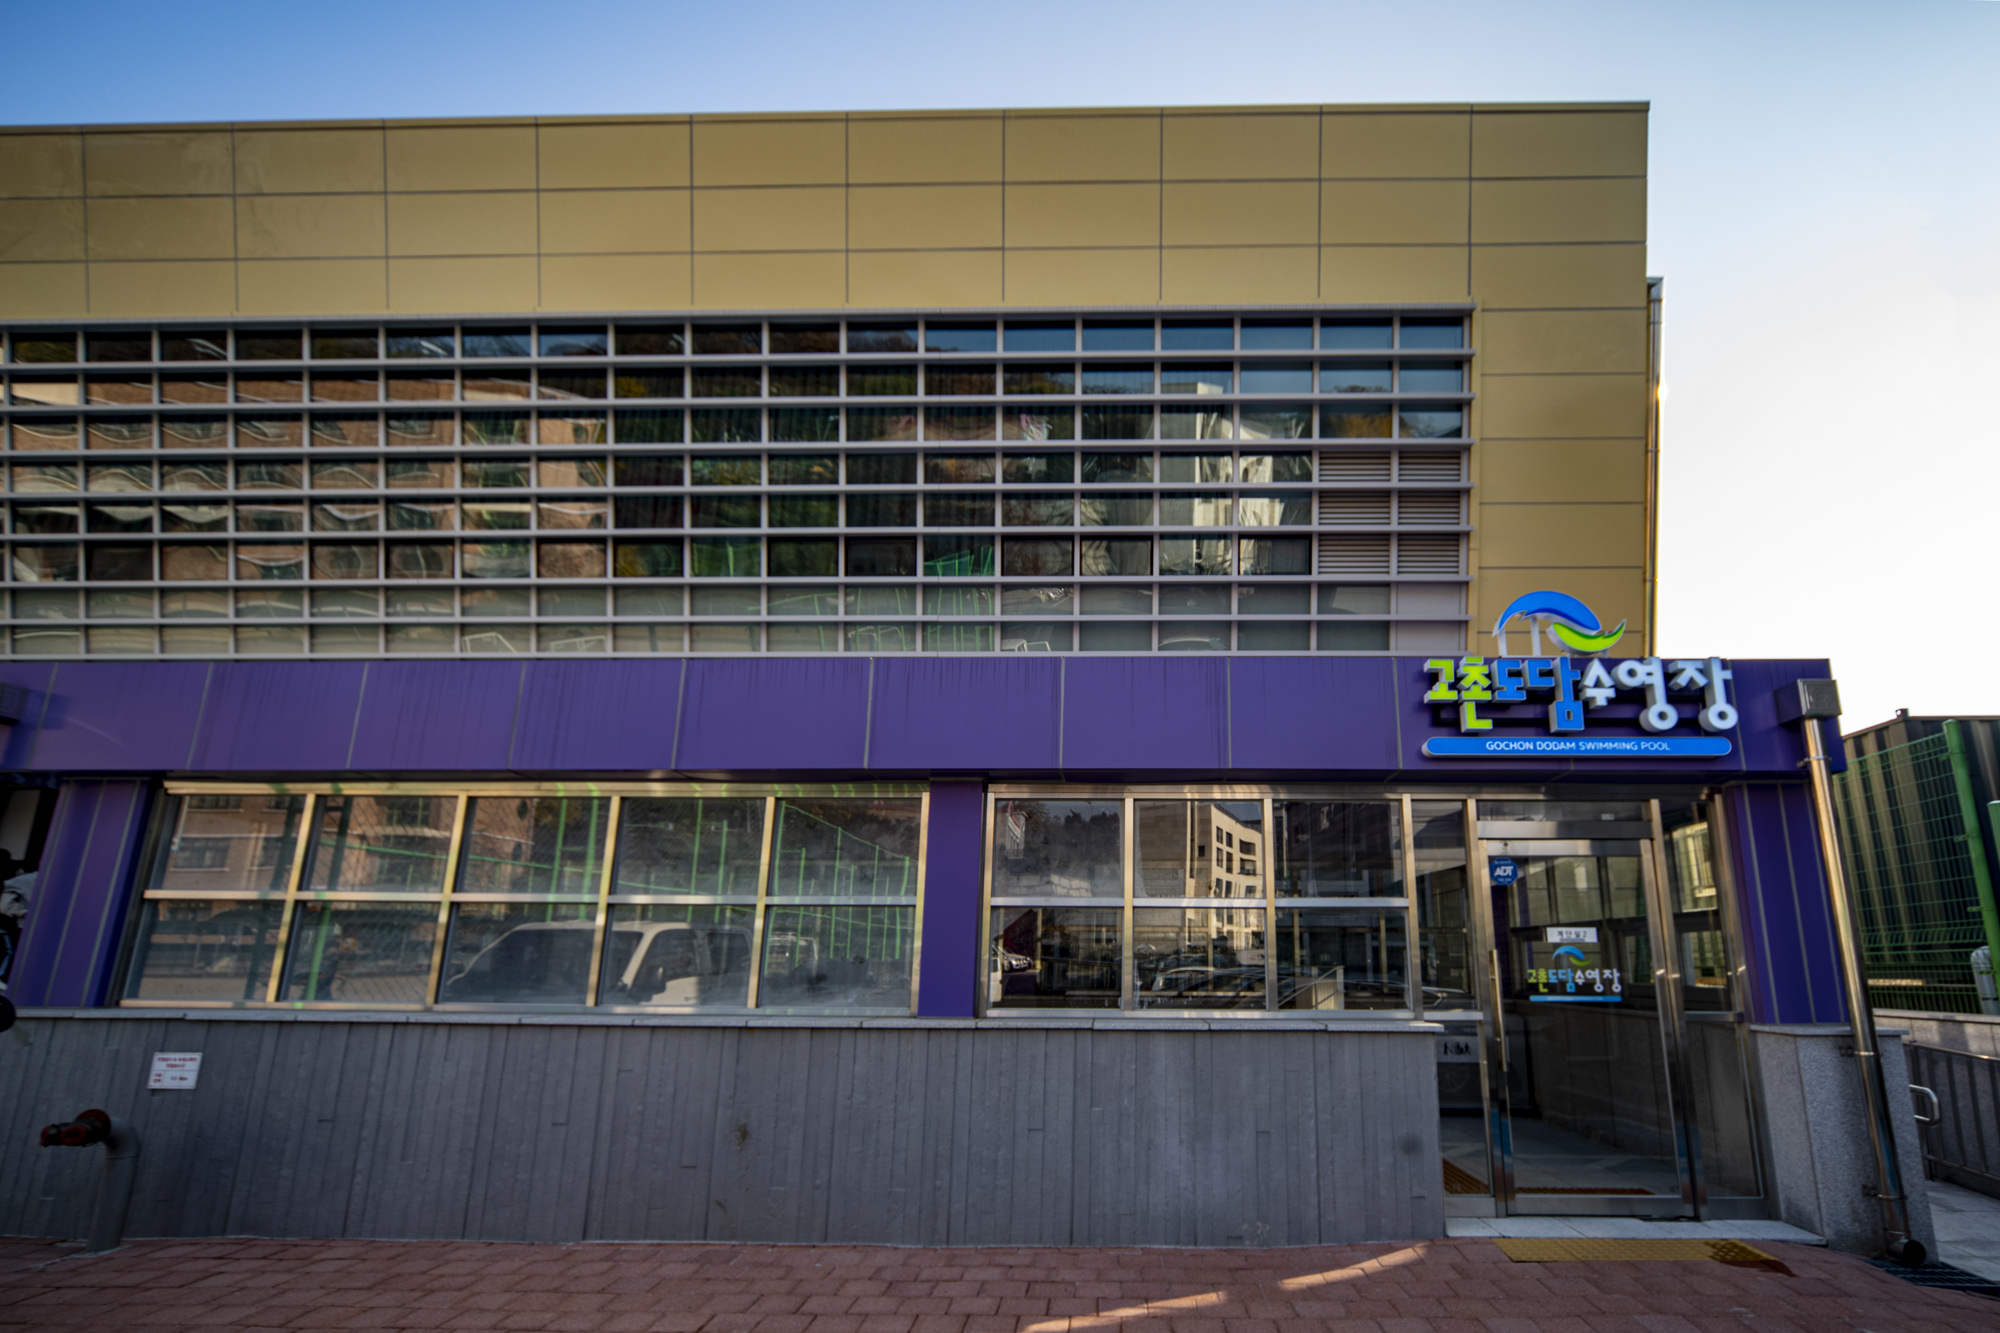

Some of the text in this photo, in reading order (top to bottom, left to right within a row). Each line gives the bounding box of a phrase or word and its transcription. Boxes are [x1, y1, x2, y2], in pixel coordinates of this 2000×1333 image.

[1485, 740, 1671, 751] GOCHON DODAM SWIMMING POOL
[1494, 866, 1514, 877] ADT
